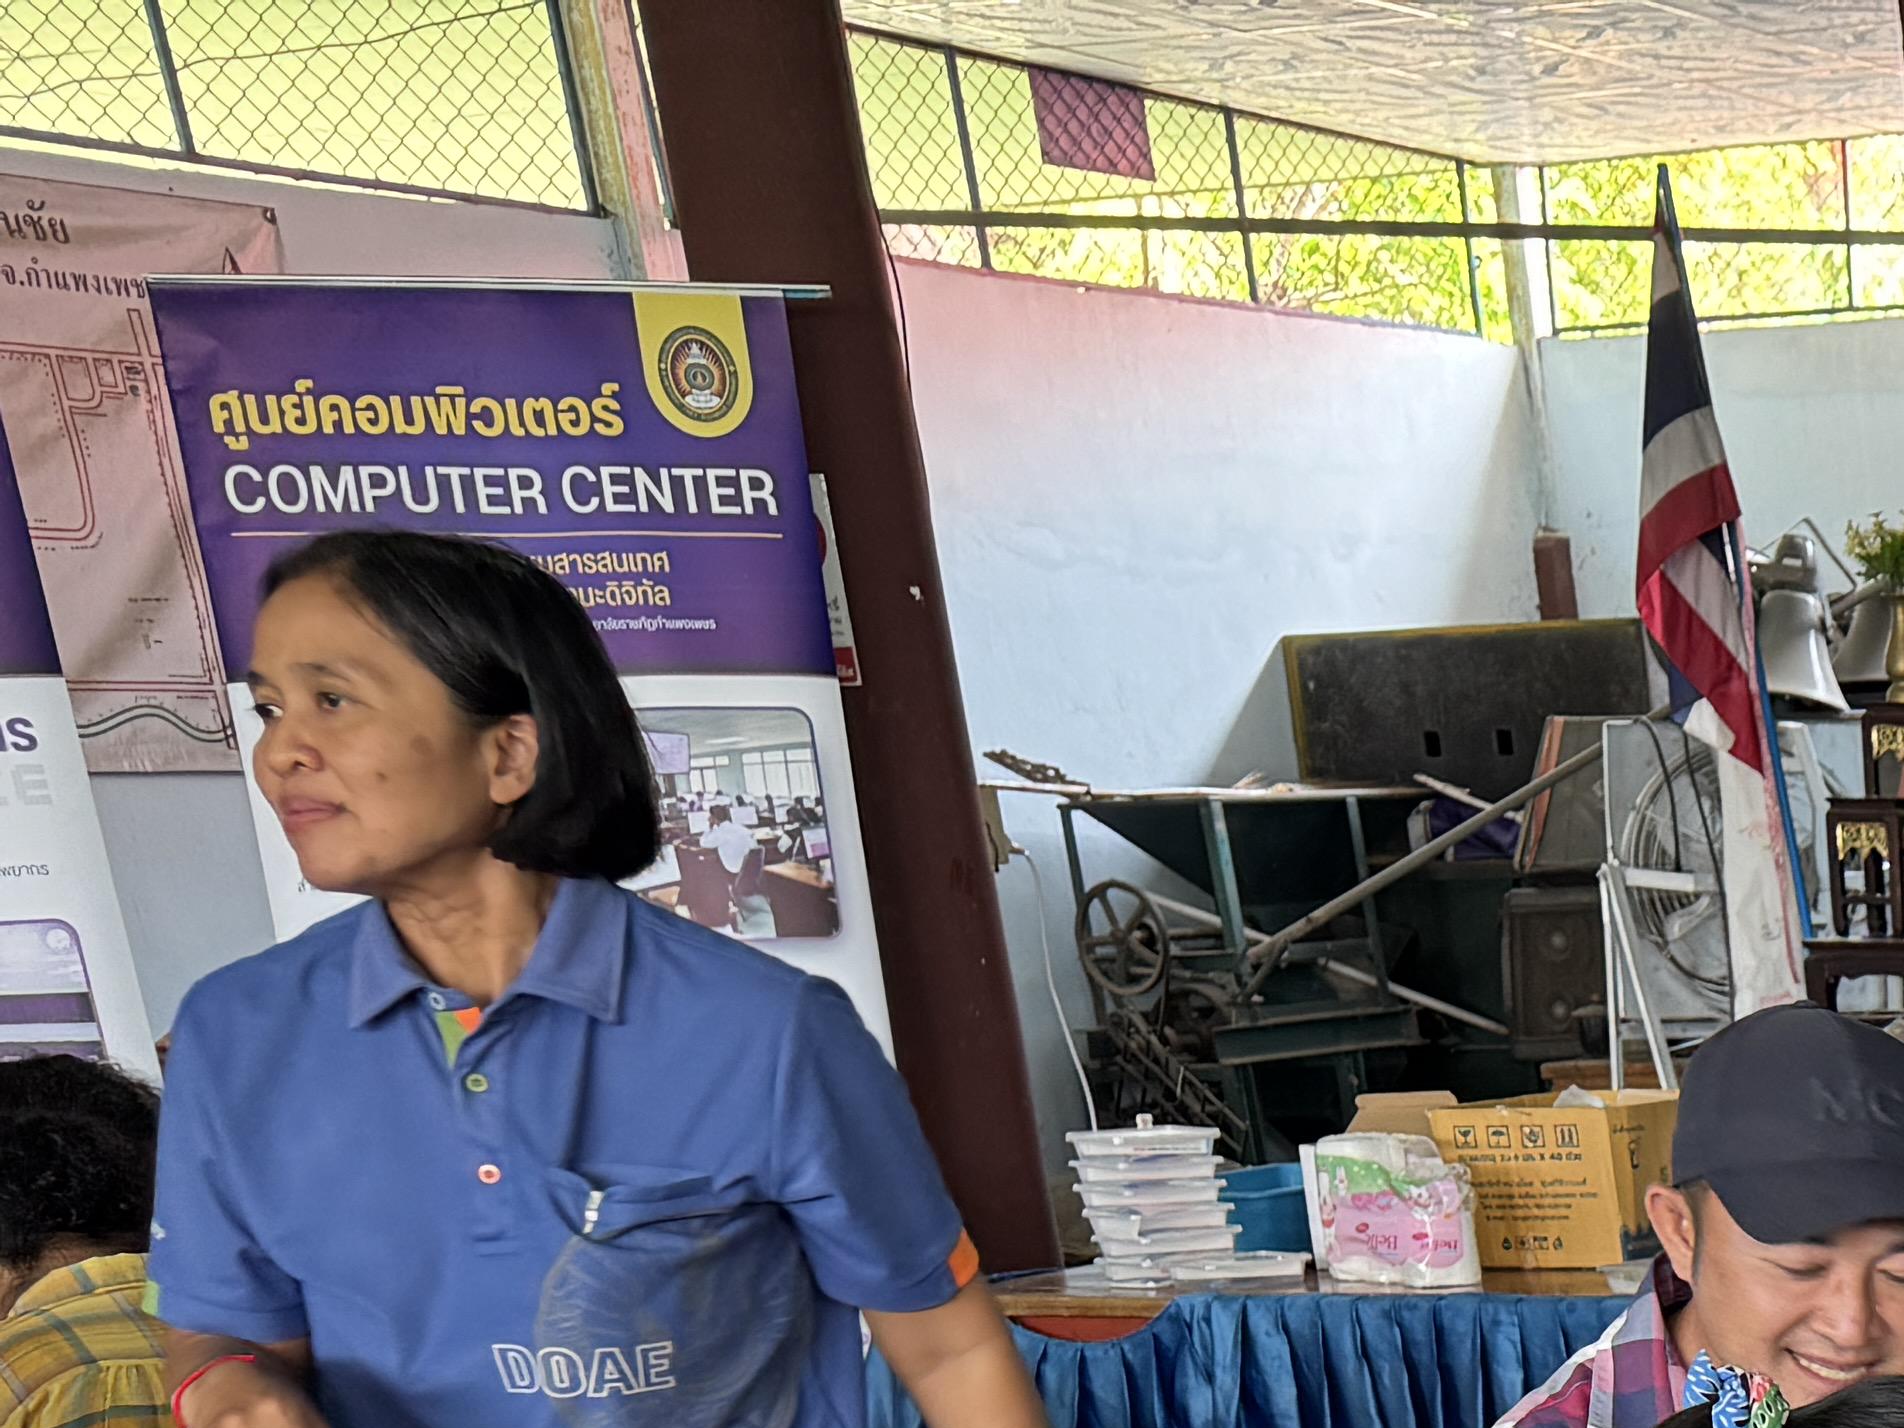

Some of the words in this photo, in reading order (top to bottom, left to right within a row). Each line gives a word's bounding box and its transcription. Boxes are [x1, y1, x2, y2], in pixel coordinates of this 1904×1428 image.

[208, 379, 625, 451] ศูนย์คอมพิวเตอร์
[223, 464, 548, 516] COMPUTER
[561, 466, 780, 516] CENTER
[492, 1341, 677, 1399] DOAE
